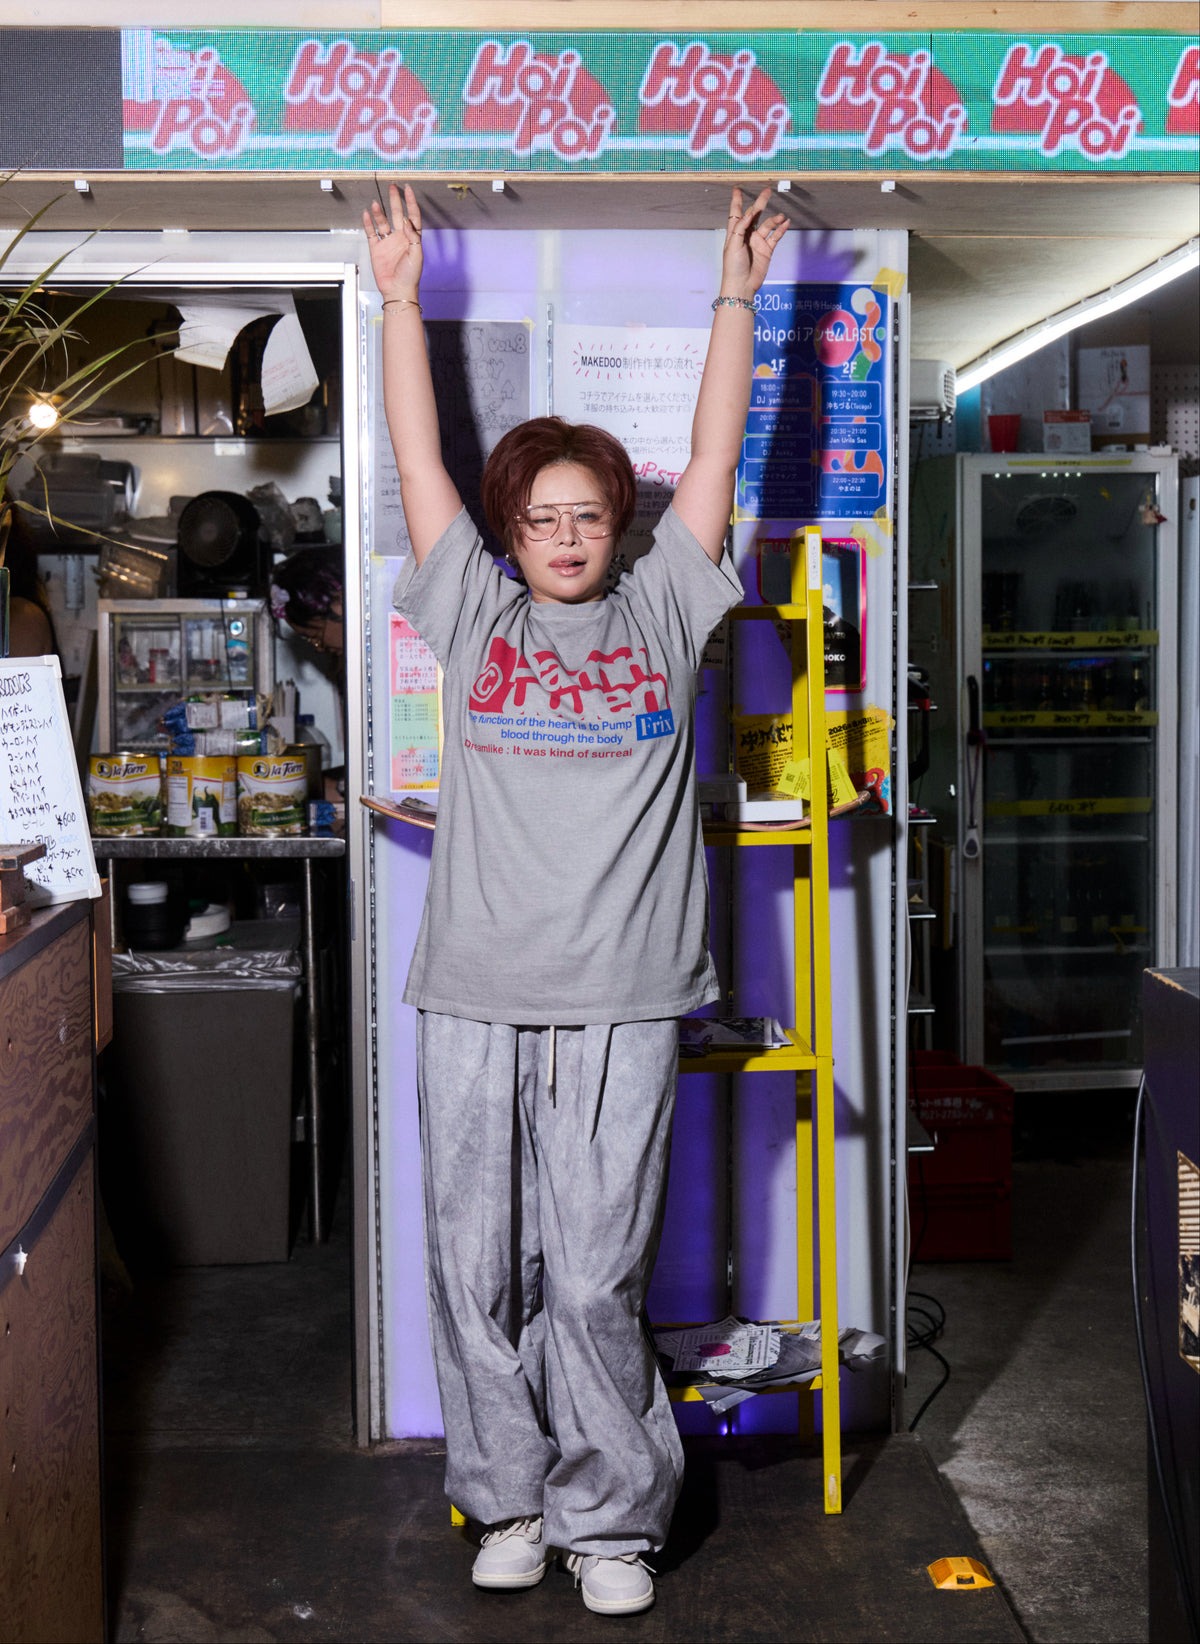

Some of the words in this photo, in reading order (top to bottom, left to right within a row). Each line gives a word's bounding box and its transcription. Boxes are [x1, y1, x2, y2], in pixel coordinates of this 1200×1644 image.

[285, 40, 401, 102] Hoi
[464, 40, 581, 103] Hoi
[640, 41, 756, 104] Hoi
[816, 41, 930, 104] Hoi
[991, 42, 1107, 106] Hoi
[152, 96, 255, 159] Poi
[335, 97, 437, 160] Poi
[513, 97, 616, 160] Poi
[688, 98, 790, 161] Poi
[863, 98, 966, 161] Poi
[1040, 99, 1143, 162] Poi
[771, 359, 786, 371] 1F
[843, 362, 857, 374] 2F
[757, 396, 766, 405] DJ
[464, 738, 504, 755] Dreamlike
[513, 745, 521, 756] It
[524, 747, 546, 757] was
[549, 747, 574, 758] kind
[577, 748, 590, 758] of
[592, 747, 633, 758] surreal
[478, 714, 513, 726] function
[515, 717, 527, 727] of
[528, 718, 546, 728] the
[547, 719, 576, 730] heart
[578, 722, 587, 730] is
[588, 722, 600, 731] to
[602, 720, 633, 732] Pump
[501, 729, 529, 740] blood
[532, 730, 576, 744] through
[577, 733, 595, 744] the
[597, 734, 624, 745] body
[122, 762, 147, 778] Torre
[278, 762, 303, 777] Torre
